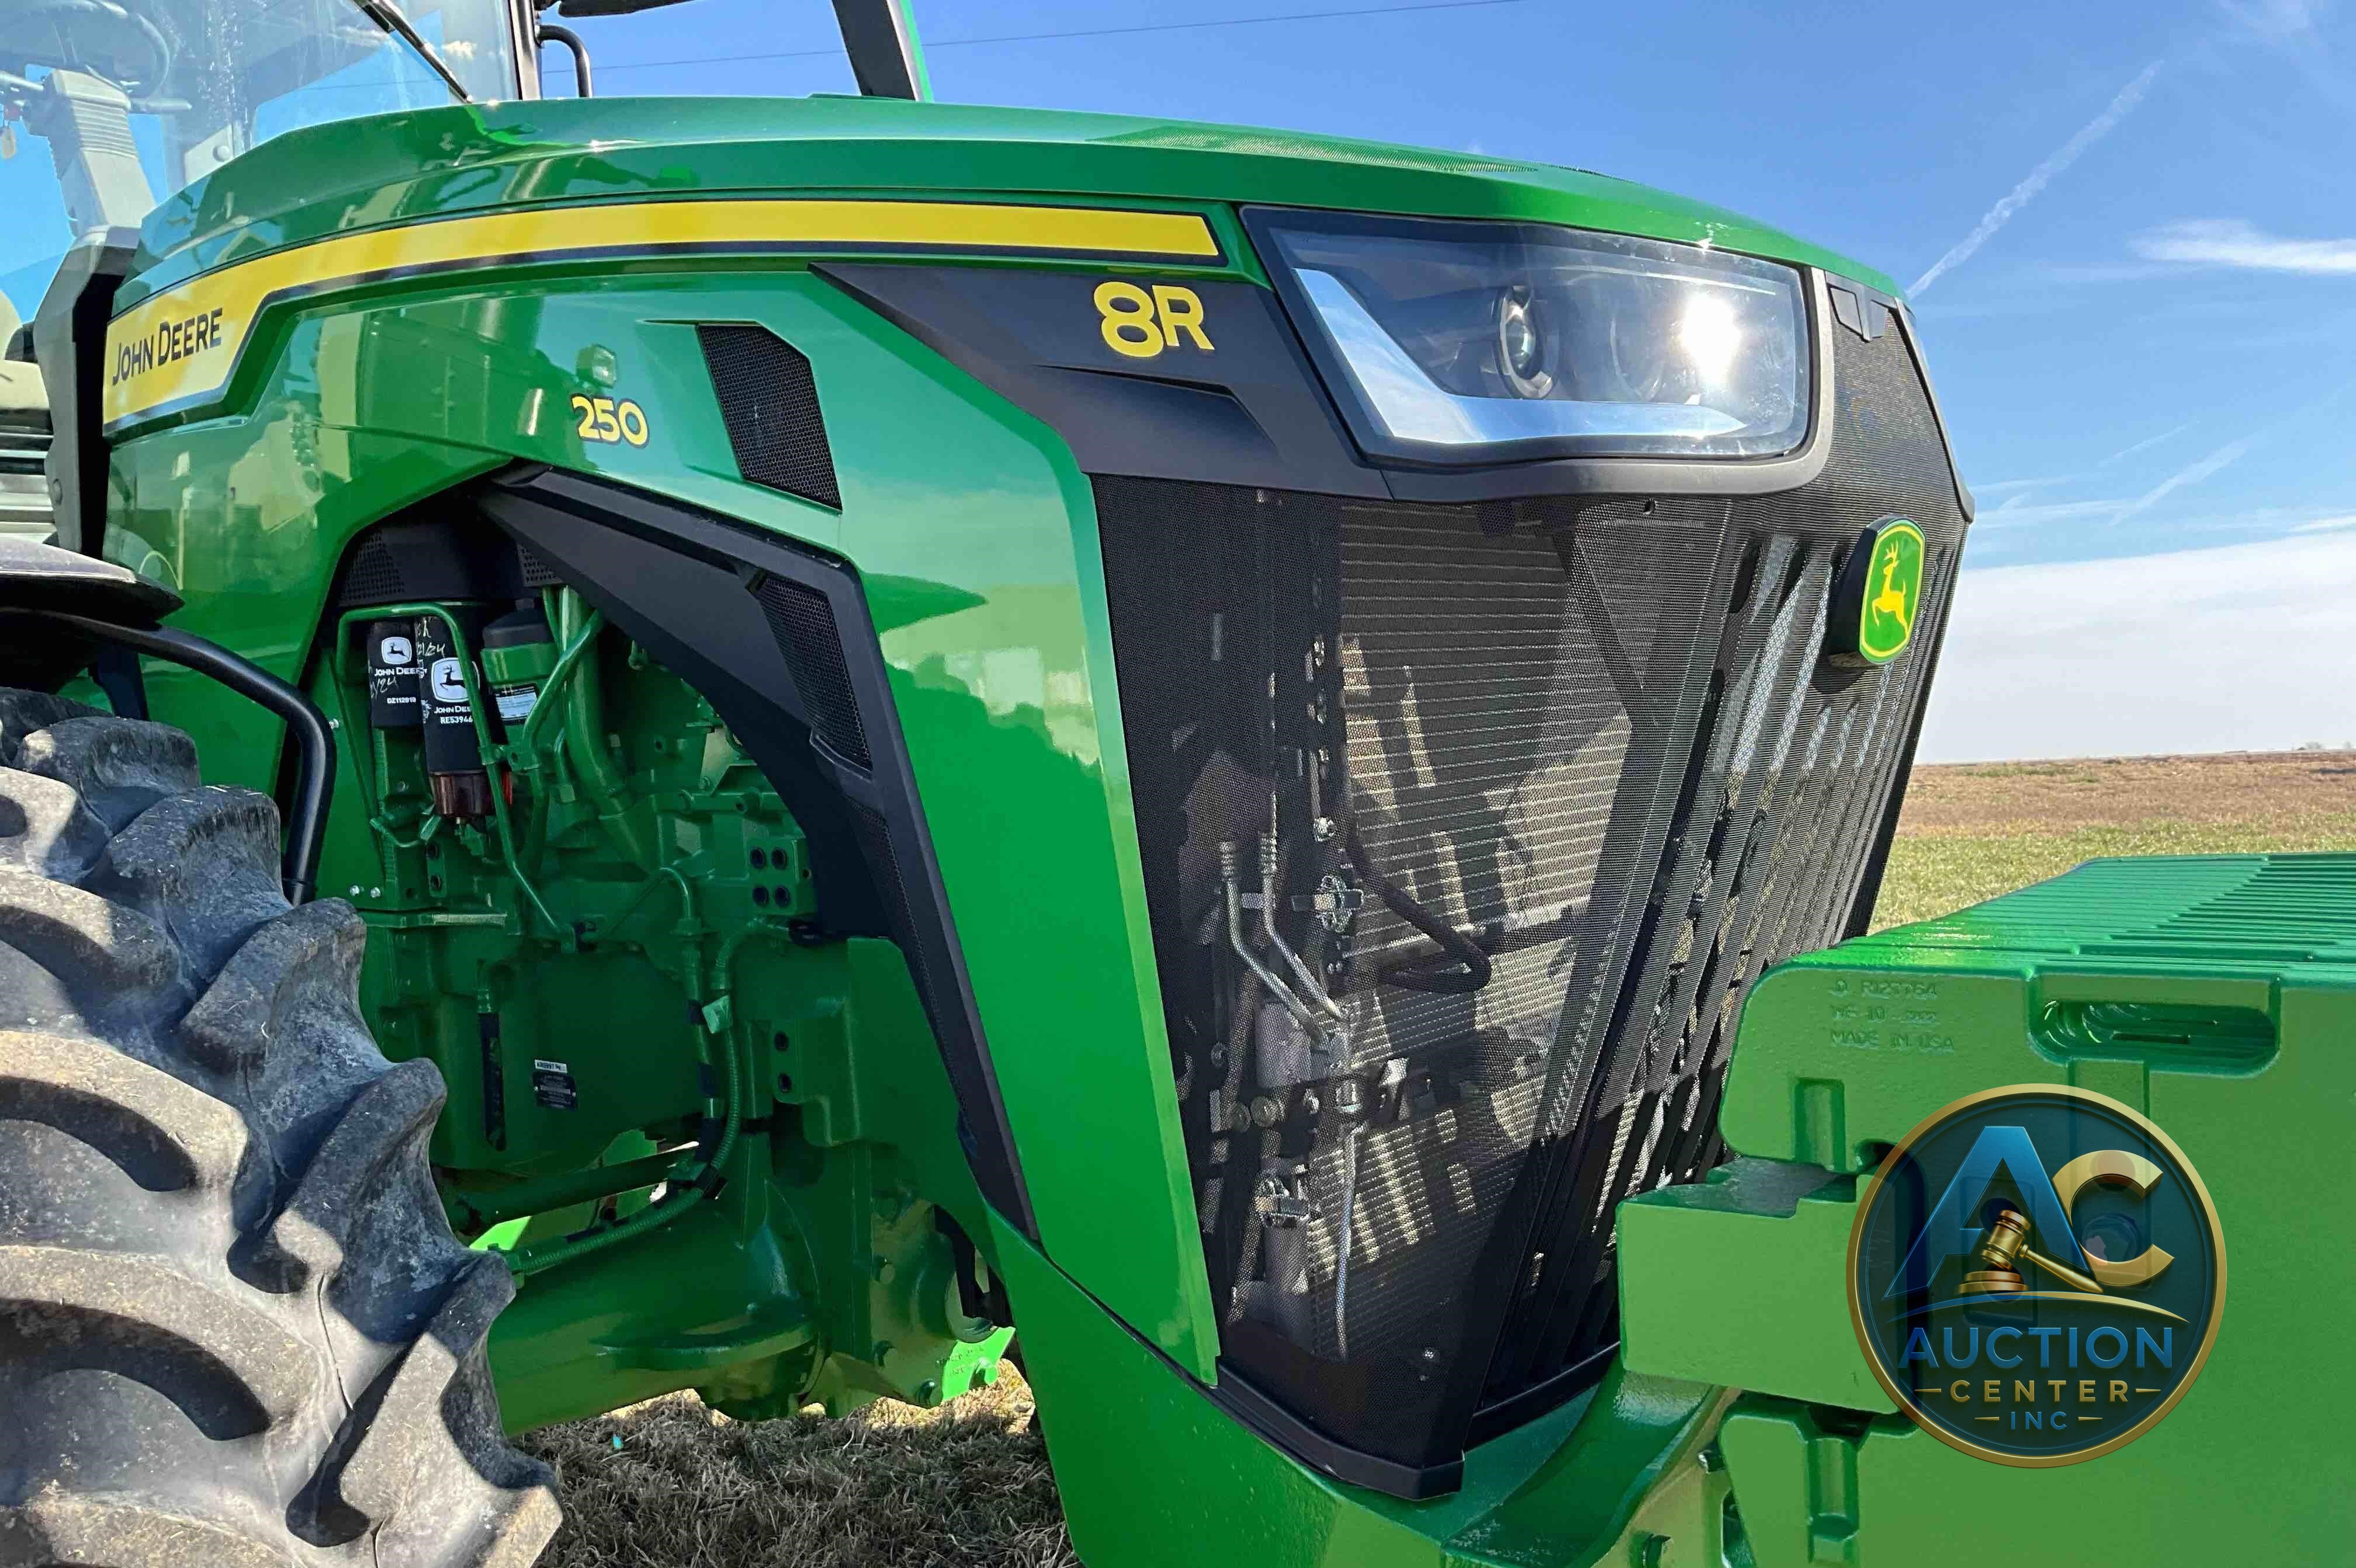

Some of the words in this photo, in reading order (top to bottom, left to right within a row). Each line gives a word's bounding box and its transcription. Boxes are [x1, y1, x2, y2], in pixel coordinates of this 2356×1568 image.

[1093, 281, 1215, 358] 8R
[112, 334, 154, 386] JOHN
[158, 307, 223, 366] DEERE
[570, 393, 650, 449] 250
[374, 668, 395, 677] JOHN
[396, 667, 422, 675] DEE
[434, 706, 454, 714] JOHN
[1830, 1029, 1880, 1047] MADE
[1891, 1032, 1910, 1049] IN
[1918, 1034, 1955, 1050] USA
